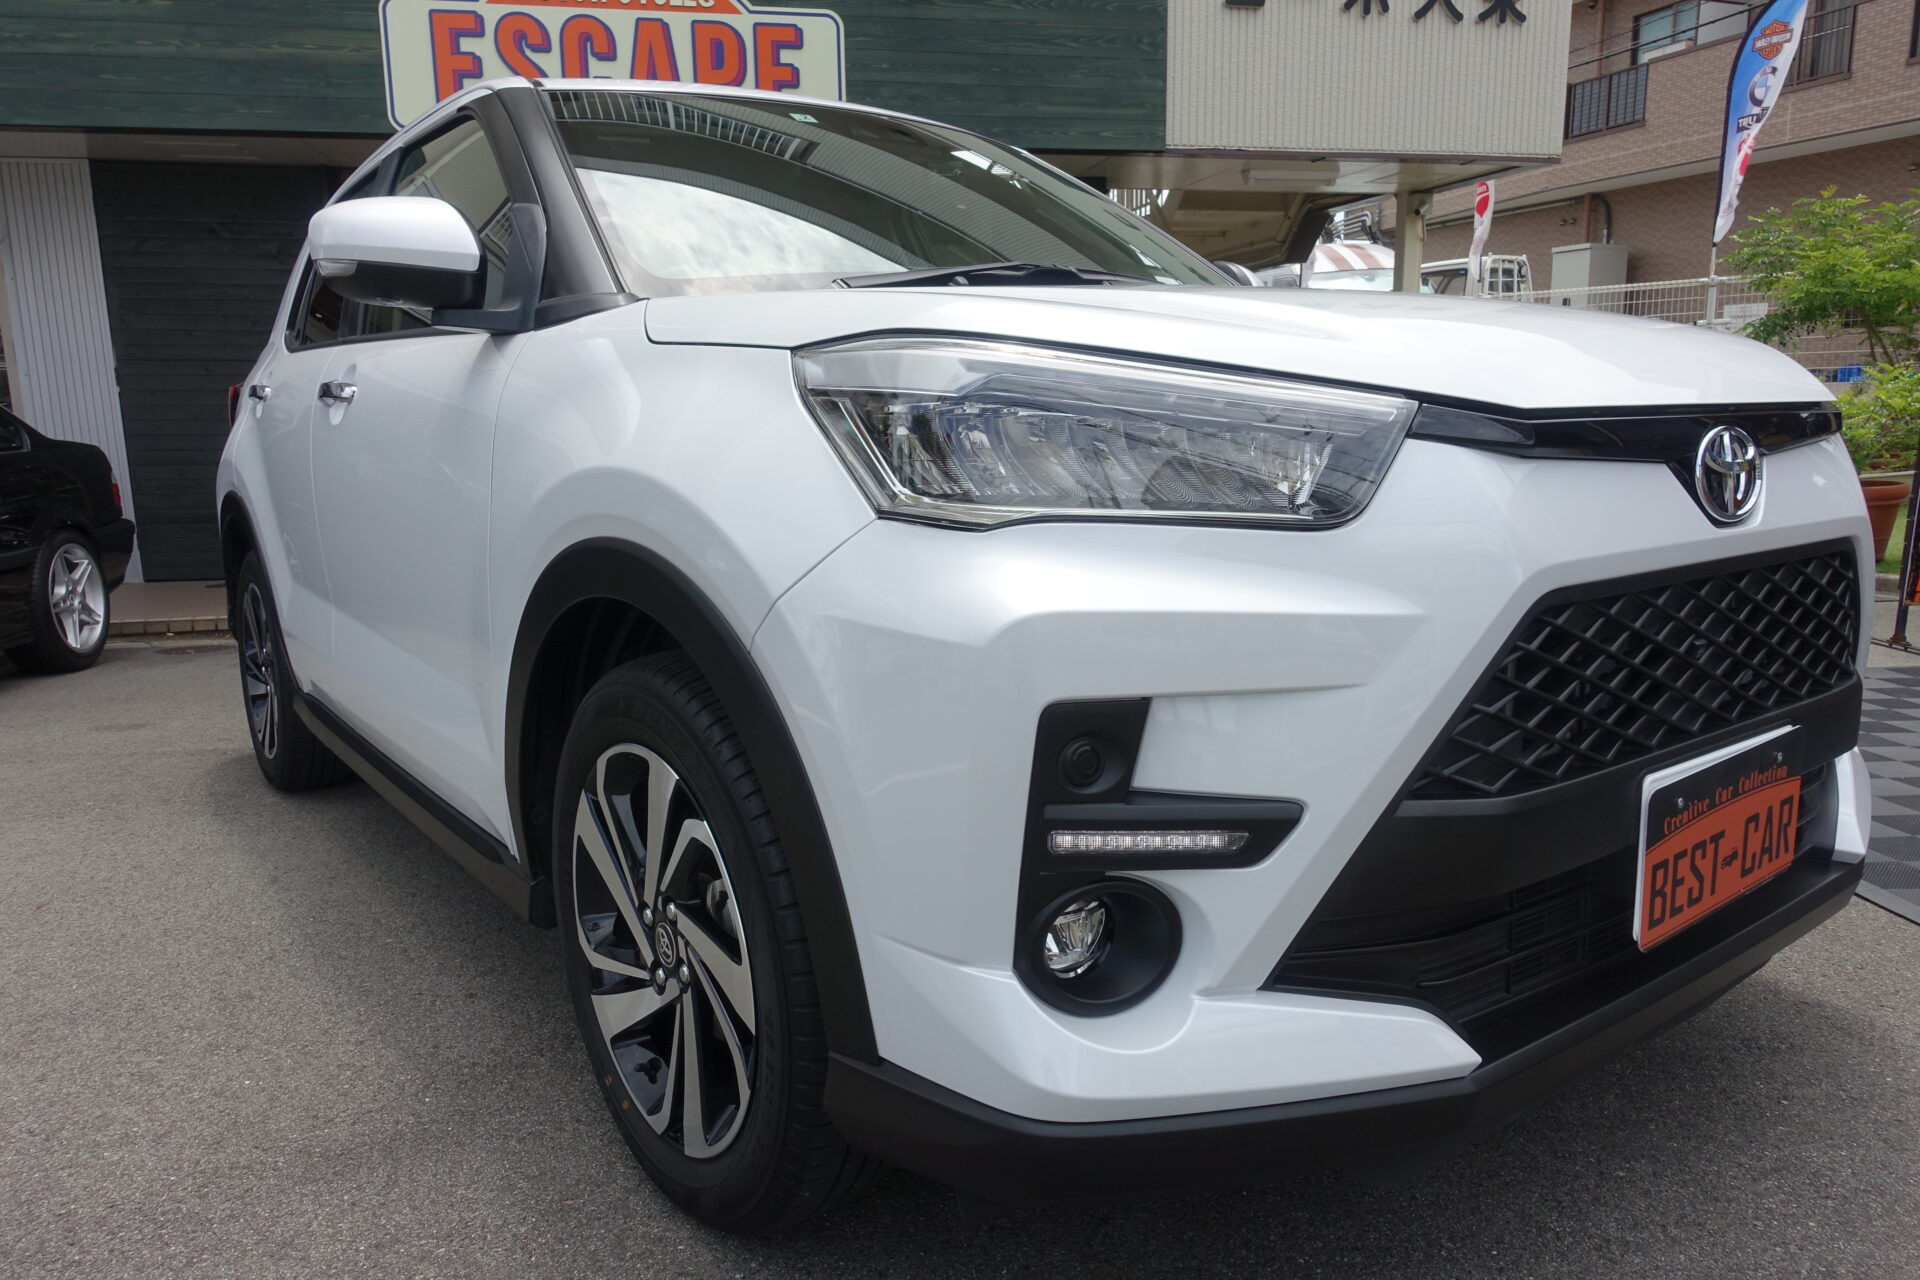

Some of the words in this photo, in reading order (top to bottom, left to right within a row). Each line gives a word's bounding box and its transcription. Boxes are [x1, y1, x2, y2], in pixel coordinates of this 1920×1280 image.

[428, 9, 804, 102] ESCAPE
[1665, 800, 1709, 835] Creative
[1715, 786, 1734, 805] Car
[1738, 765, 1788, 793] Collection
[1649, 830, 1725, 930] BEST
[1741, 795, 1794, 878] CAR
